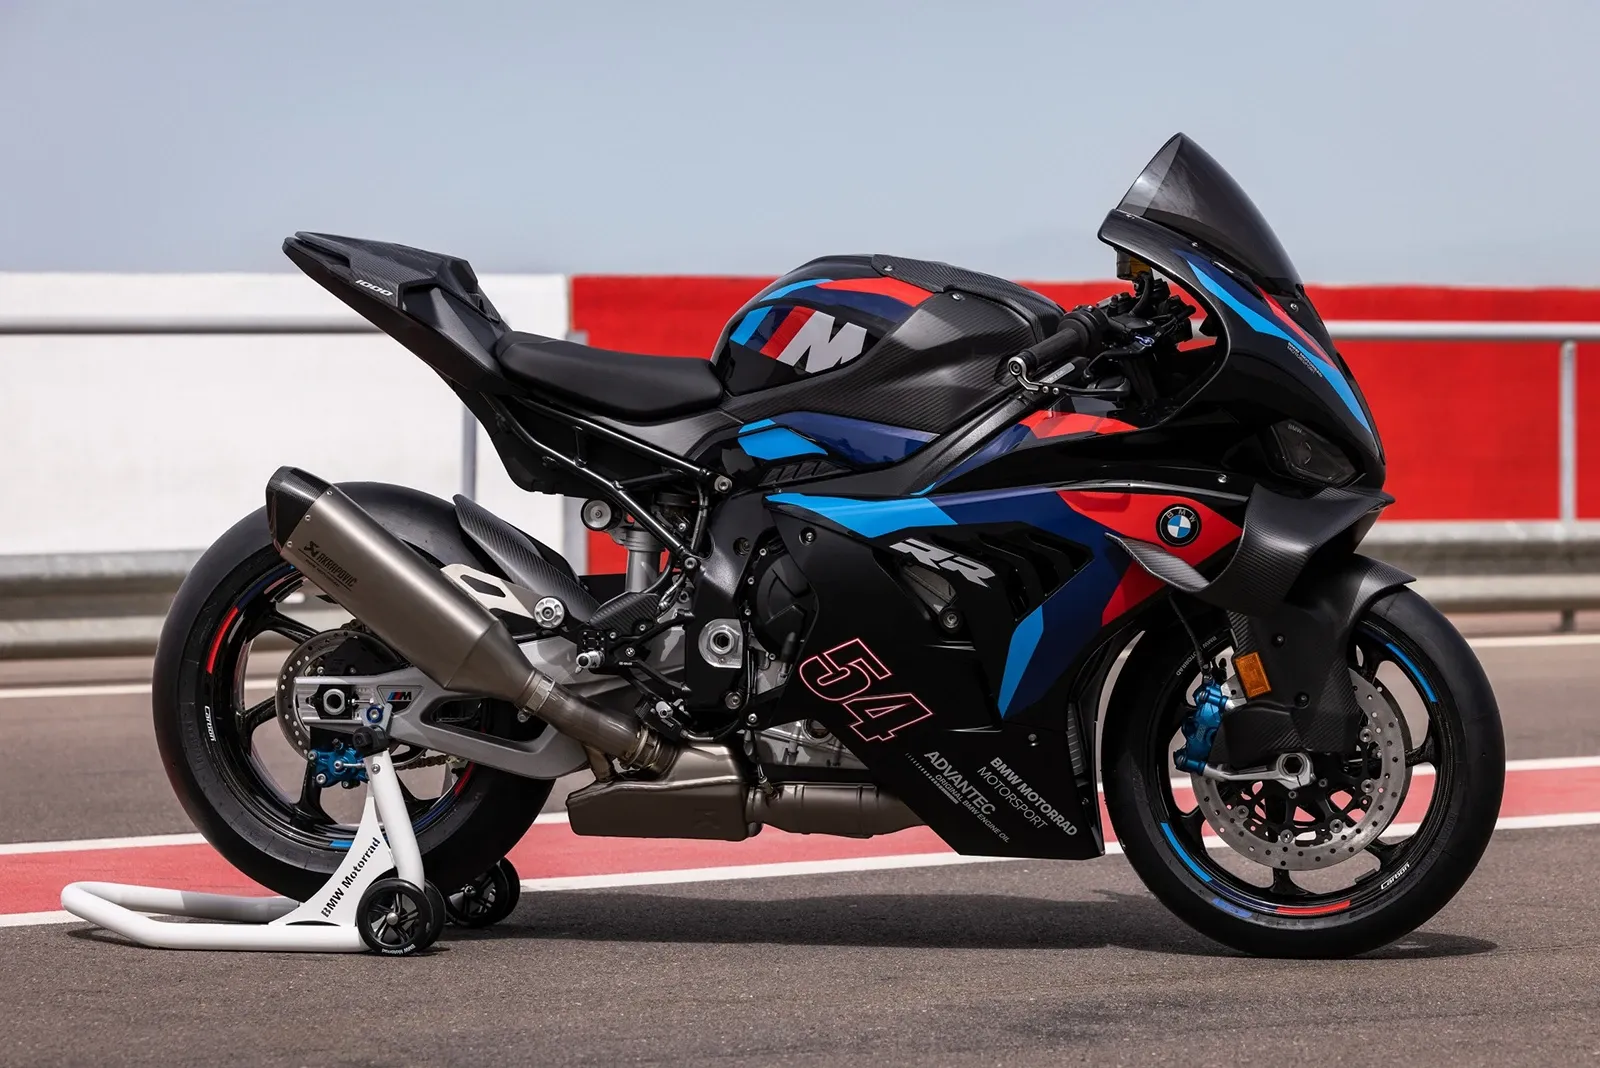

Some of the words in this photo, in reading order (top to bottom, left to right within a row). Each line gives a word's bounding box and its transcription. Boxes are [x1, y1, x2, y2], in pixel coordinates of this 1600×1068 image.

[355, 279, 394, 296] 1000
[776, 310, 868, 374] M
[889, 538, 996, 588] RR
[799, 638, 934, 742] 54
[204, 705, 217, 742] Carbon
[923, 751, 996, 815] ADVANTEC
[935, 774, 964, 802] ORIGINAL
[961, 800, 979, 816] BMW
[976, 813, 1002, 836] ENGINE
[999, 831, 1010, 843] OIL
[976, 766, 1049, 829] MOTORSPORT
[989, 756, 1023, 786] BMW
[1016, 782, 1078, 836] MOTORRAD
[320, 887, 345, 918] BMW
[341, 837, 381, 889] Motorrad
[1380, 862, 1410, 890] Carbon
